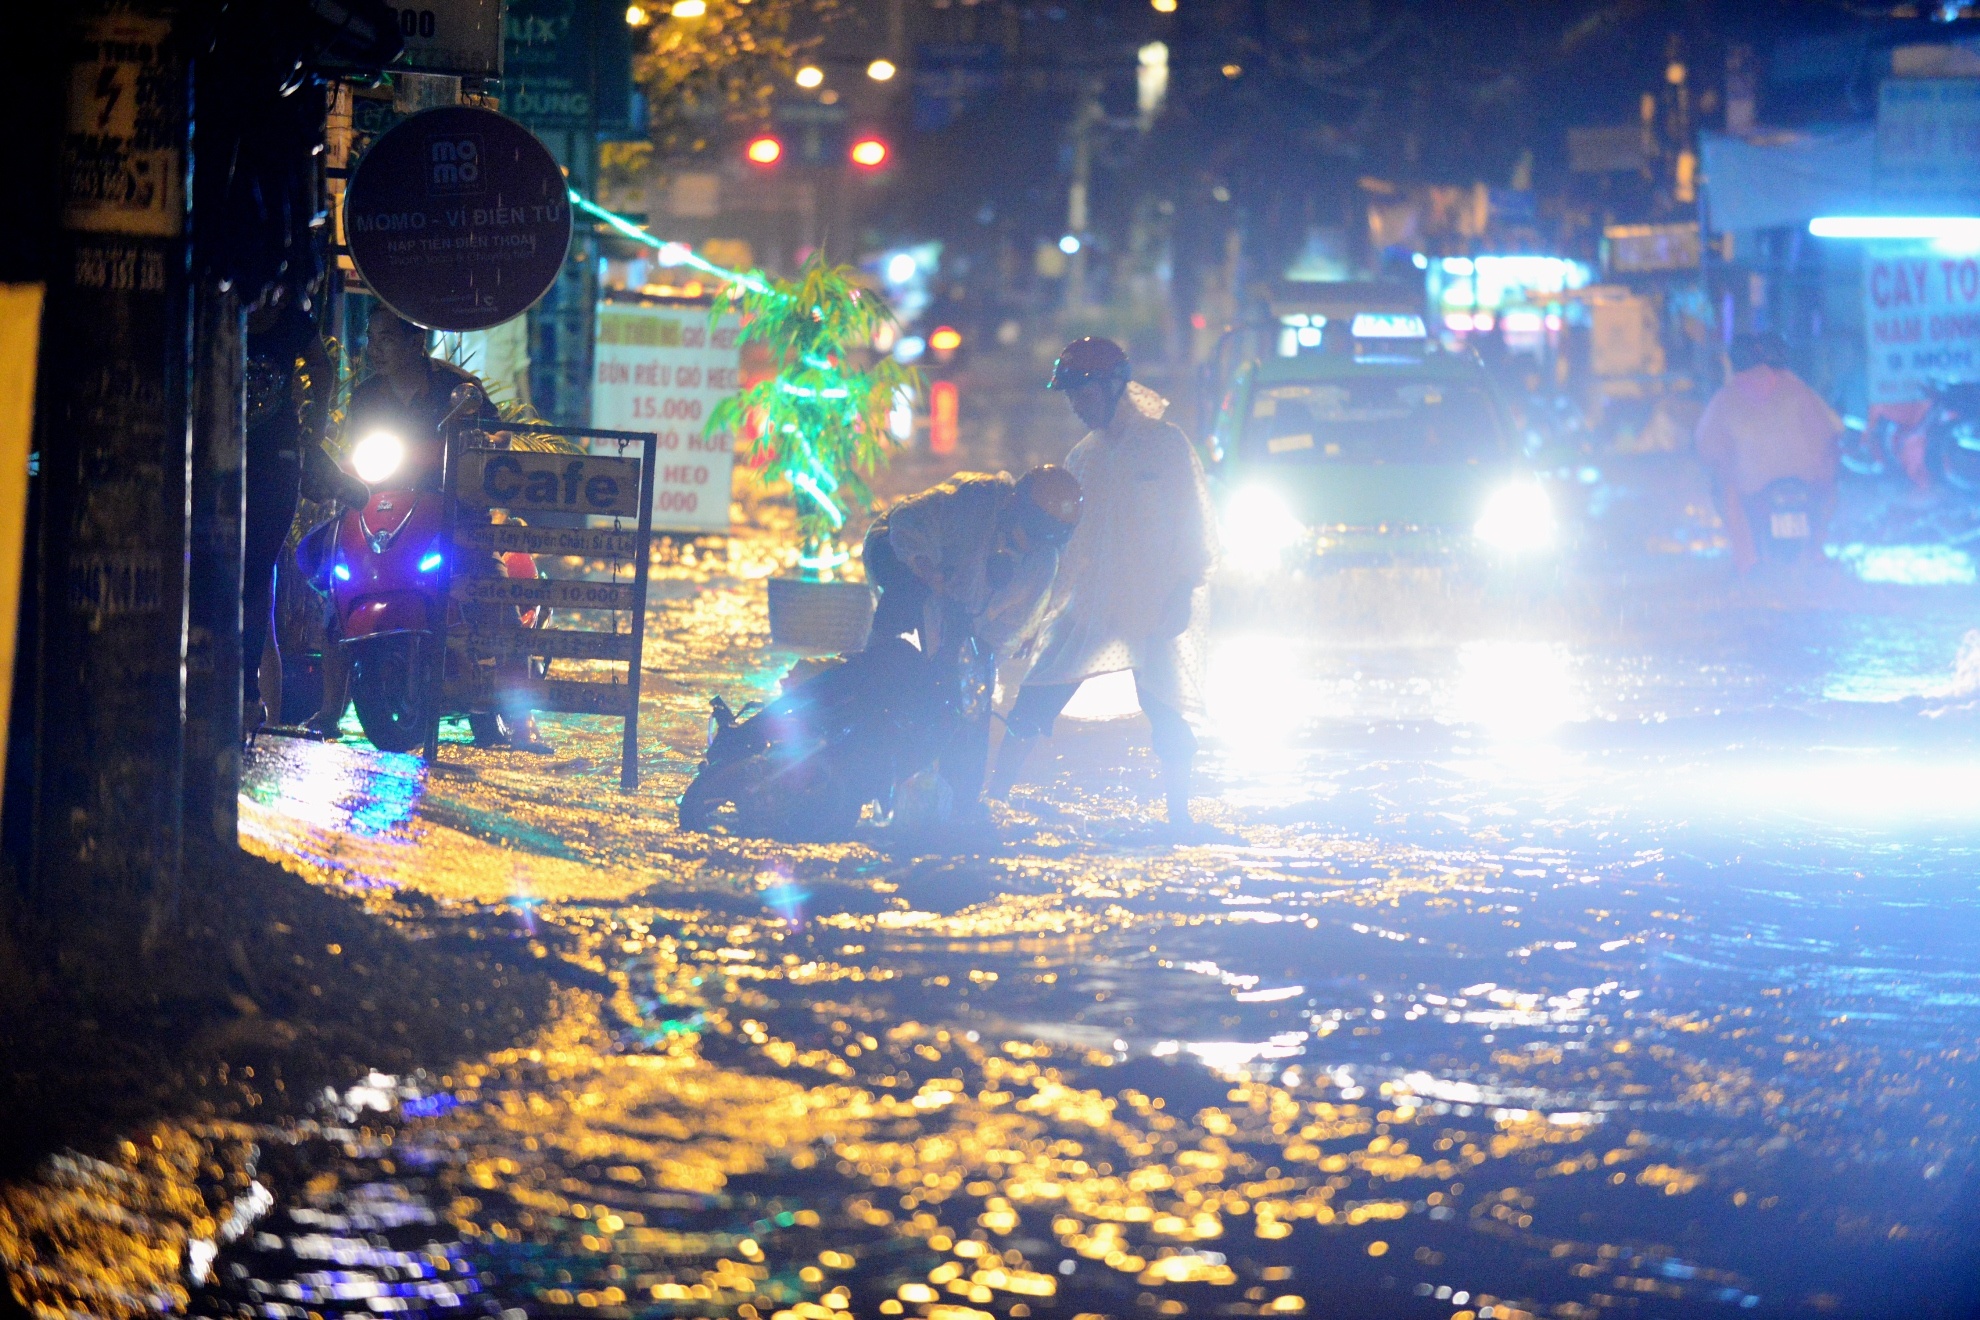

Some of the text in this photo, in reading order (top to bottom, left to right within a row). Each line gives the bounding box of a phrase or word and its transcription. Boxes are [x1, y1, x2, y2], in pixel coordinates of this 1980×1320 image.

[356, 211, 427, 232] MOMO
[632, 396, 703, 420] 15.000
[483, 454, 620, 508] Cafe
[664, 465, 709, 485] HEO
[561, 586, 619, 603] 10.000
